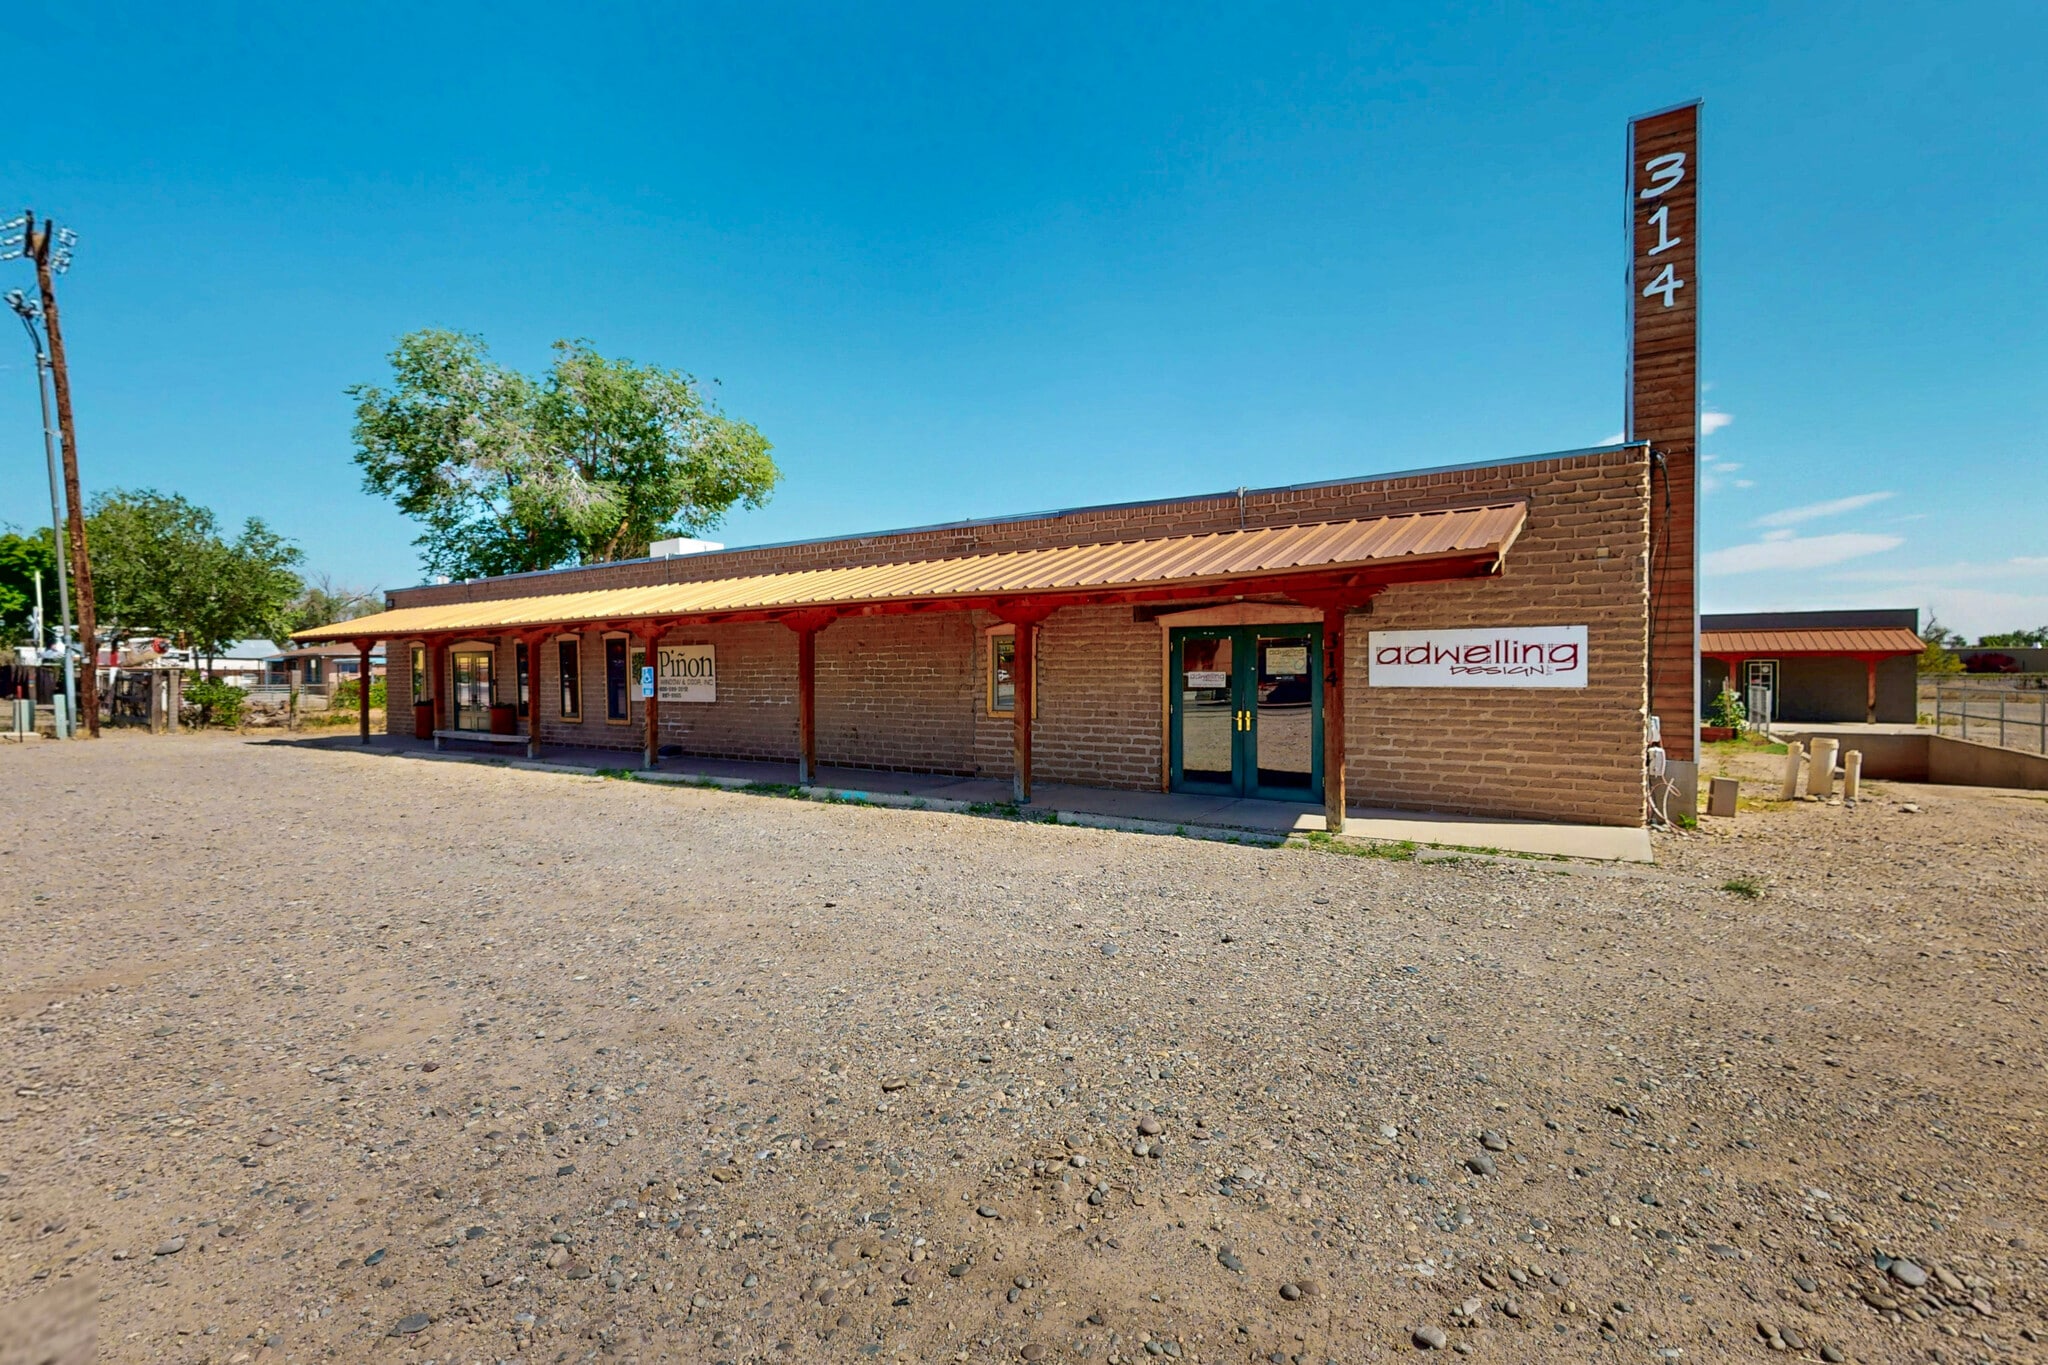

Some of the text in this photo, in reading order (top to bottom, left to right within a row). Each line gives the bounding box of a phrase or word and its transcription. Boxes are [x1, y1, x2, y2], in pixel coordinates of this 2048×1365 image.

[1639, 151, 1687, 309] 314
[659, 650, 713, 677] Piñon
[1375, 640, 1579, 672] adwelling
[1449, 664, 1545, 677] DESIGN
